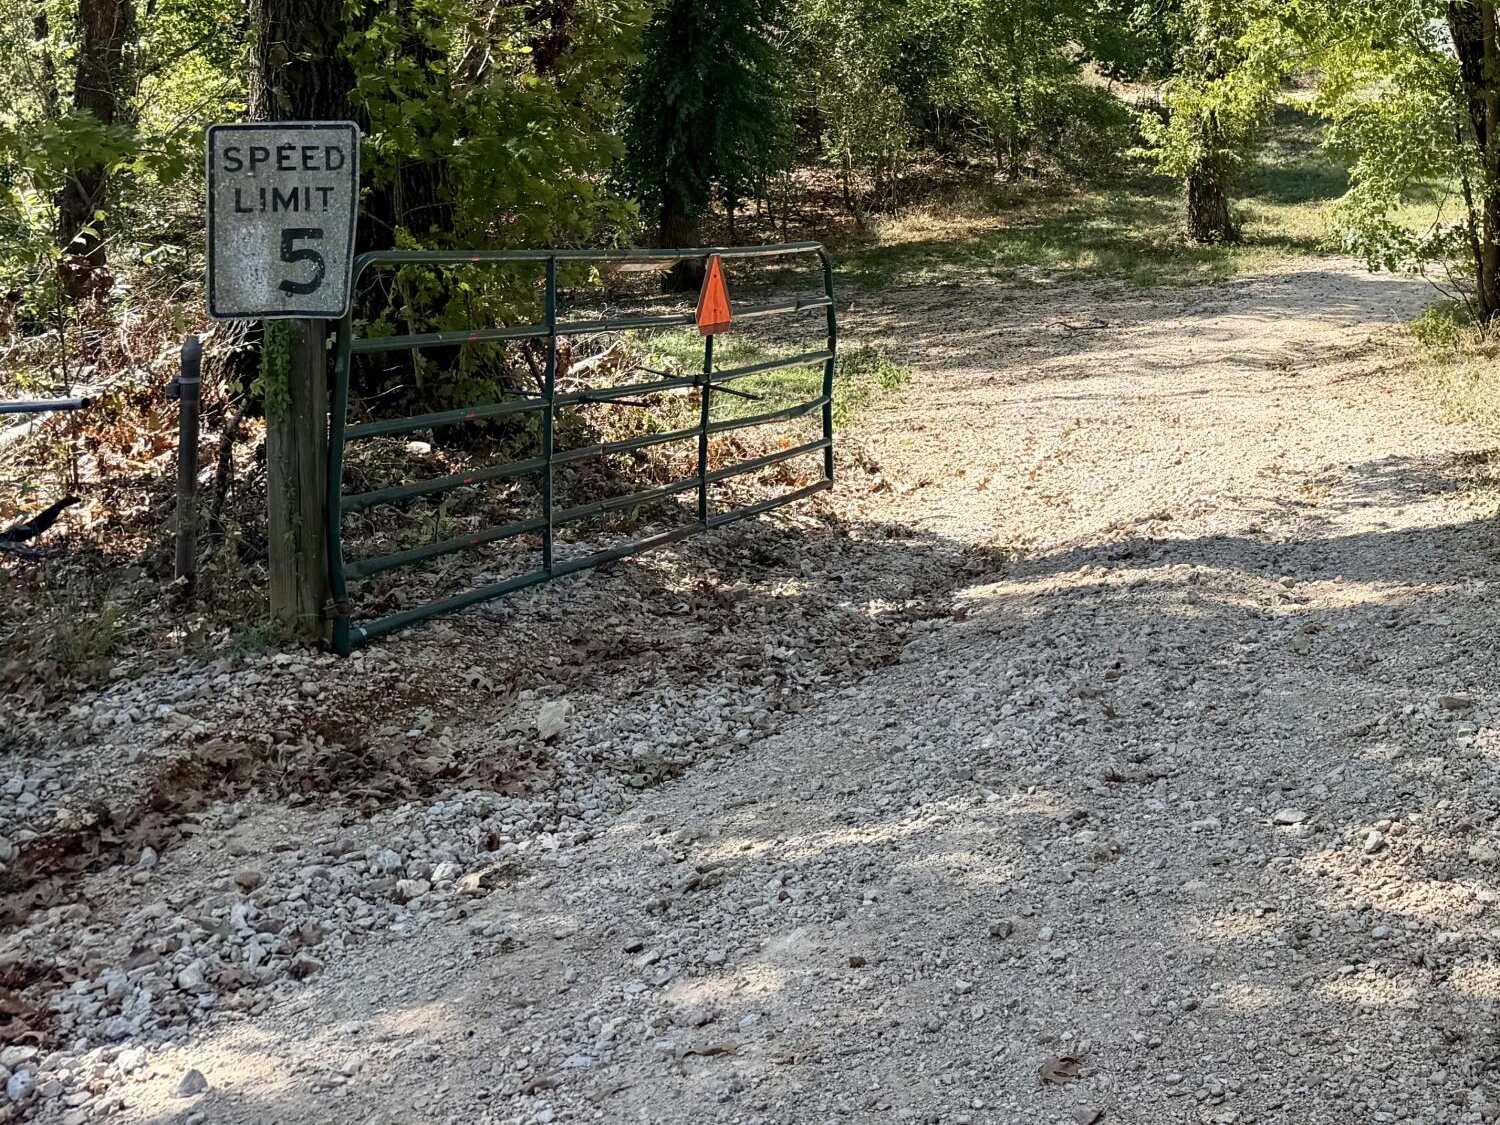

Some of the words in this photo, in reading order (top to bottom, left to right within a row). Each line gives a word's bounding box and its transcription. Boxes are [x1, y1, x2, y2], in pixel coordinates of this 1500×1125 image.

[222, 145, 346, 173] SPEED
[234, 186, 335, 214] LIMIT
[278, 227, 326, 295] 5
